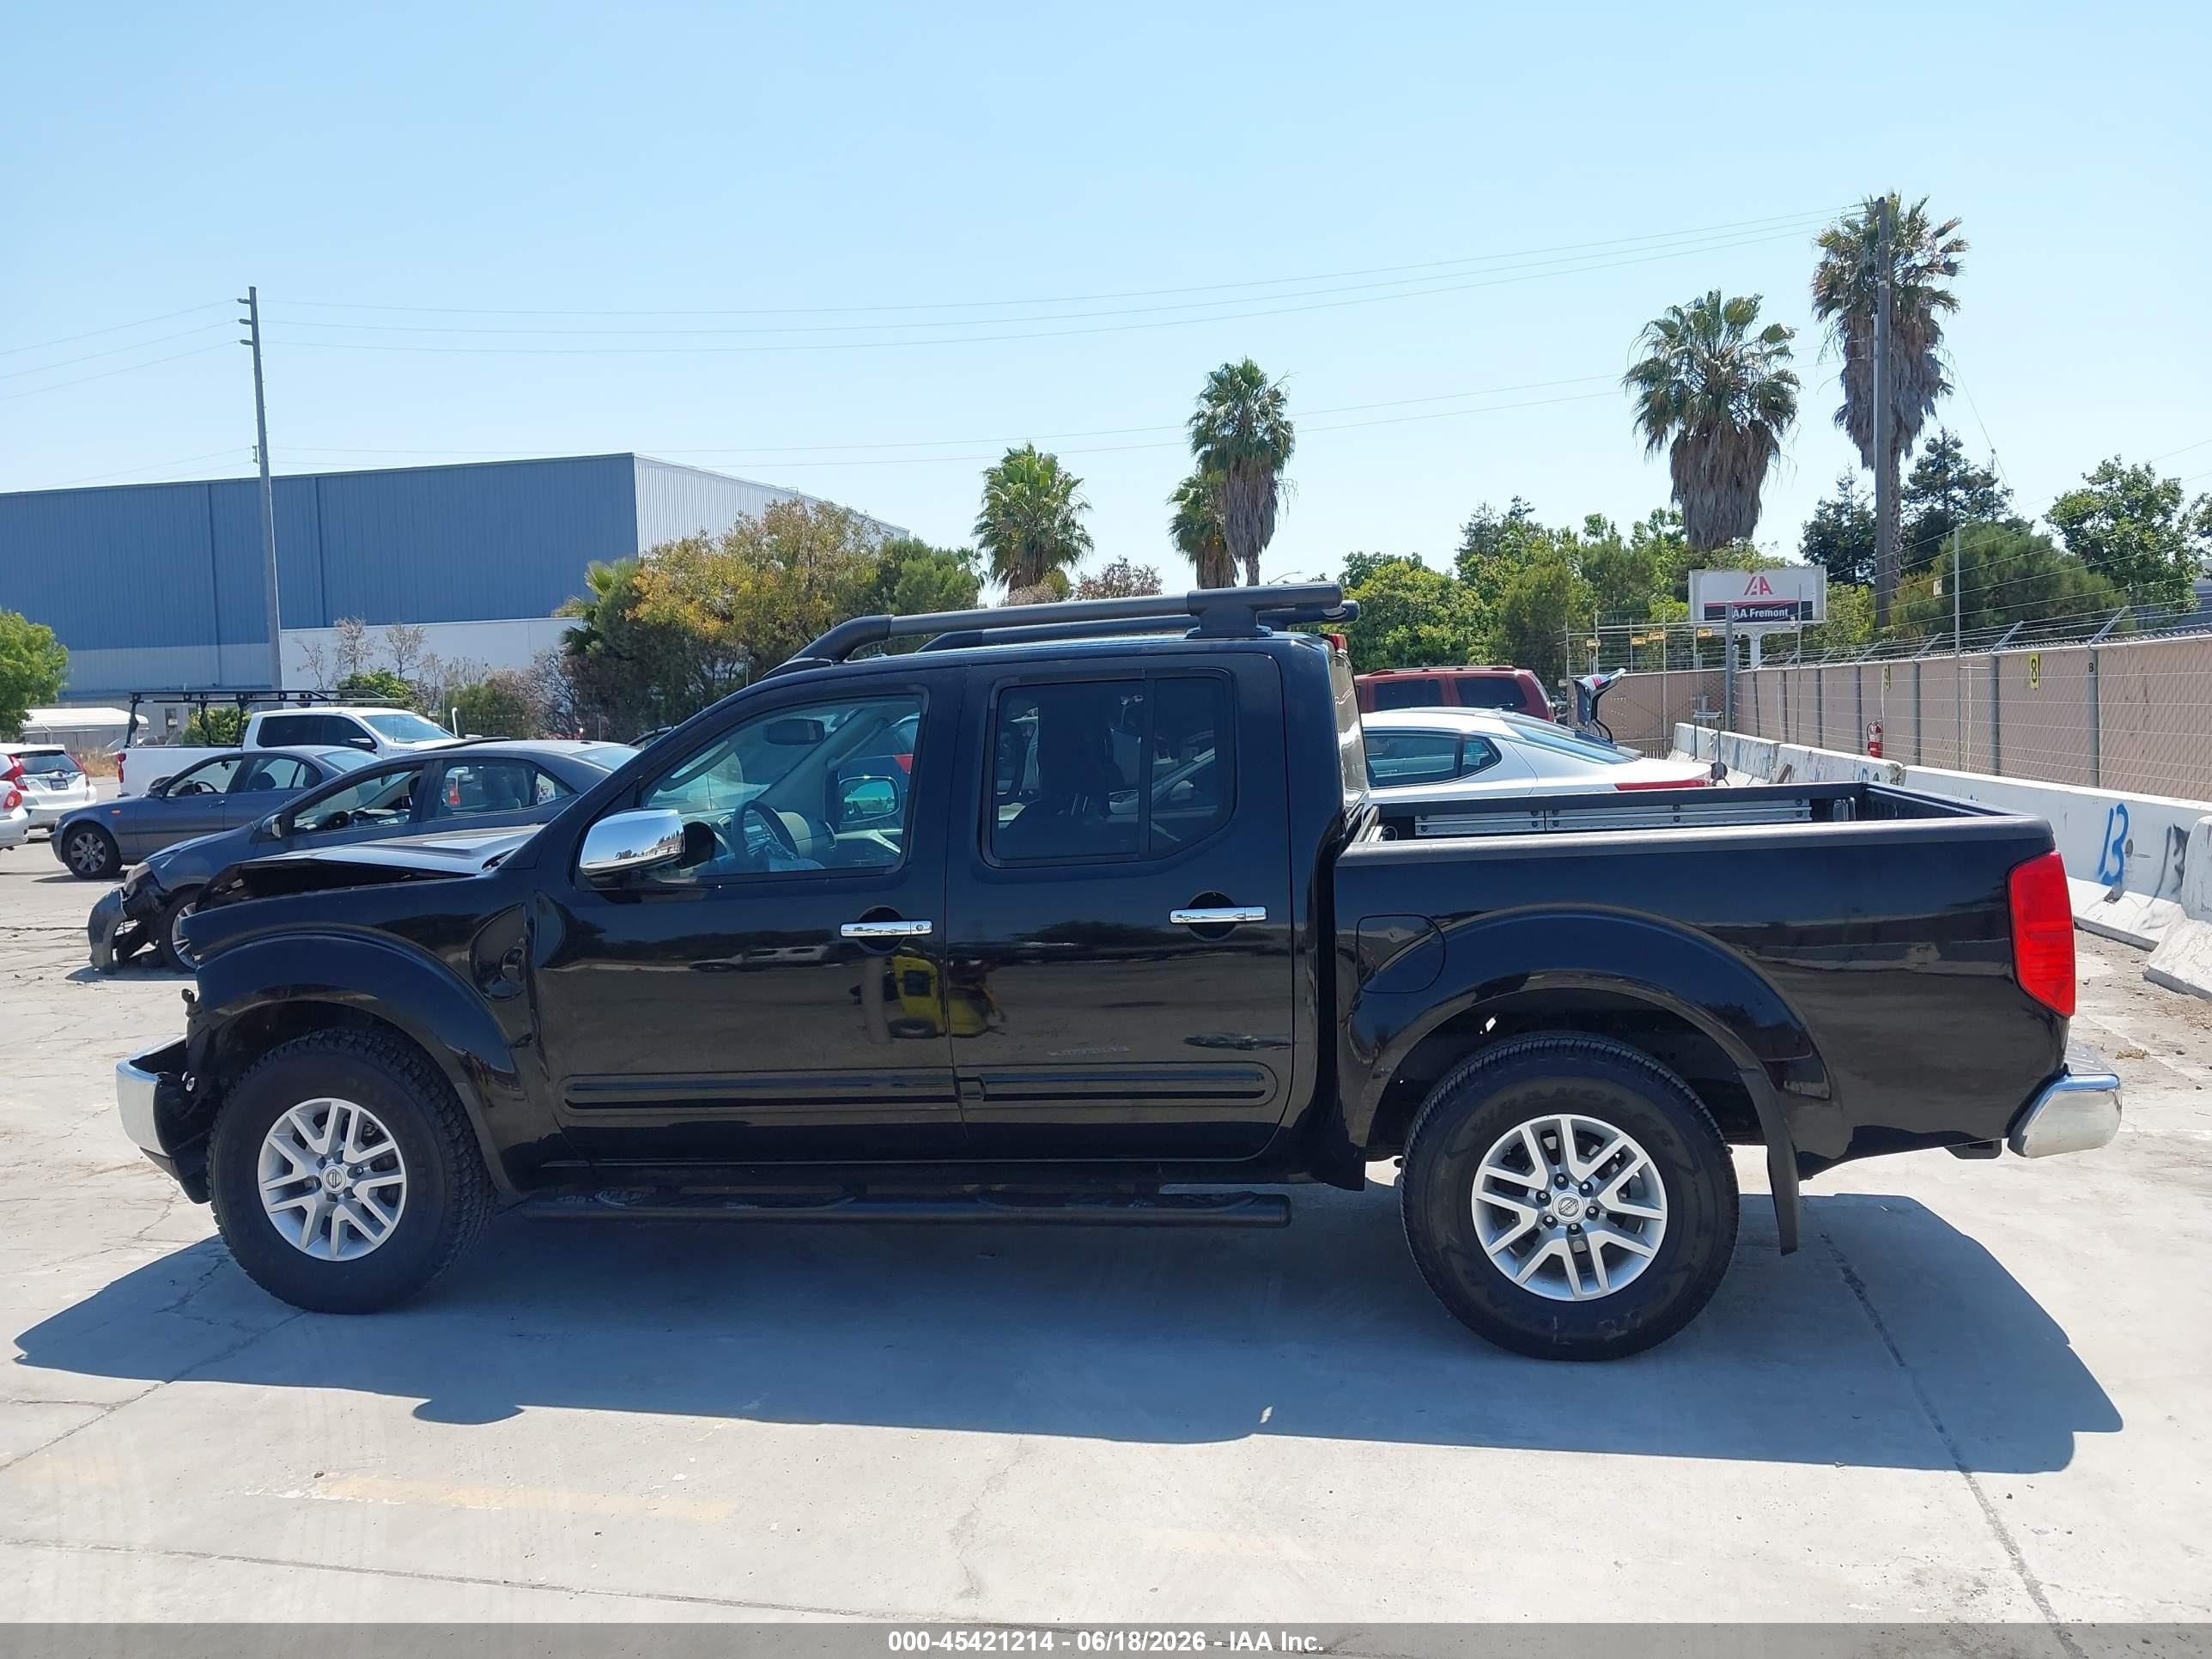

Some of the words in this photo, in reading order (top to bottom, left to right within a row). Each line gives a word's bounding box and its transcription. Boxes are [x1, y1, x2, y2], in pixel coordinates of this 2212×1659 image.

[1732, 609, 1747, 619] AA
[1749, 608, 1790, 618] Fremont
[2030, 658, 2039, 684] 8
